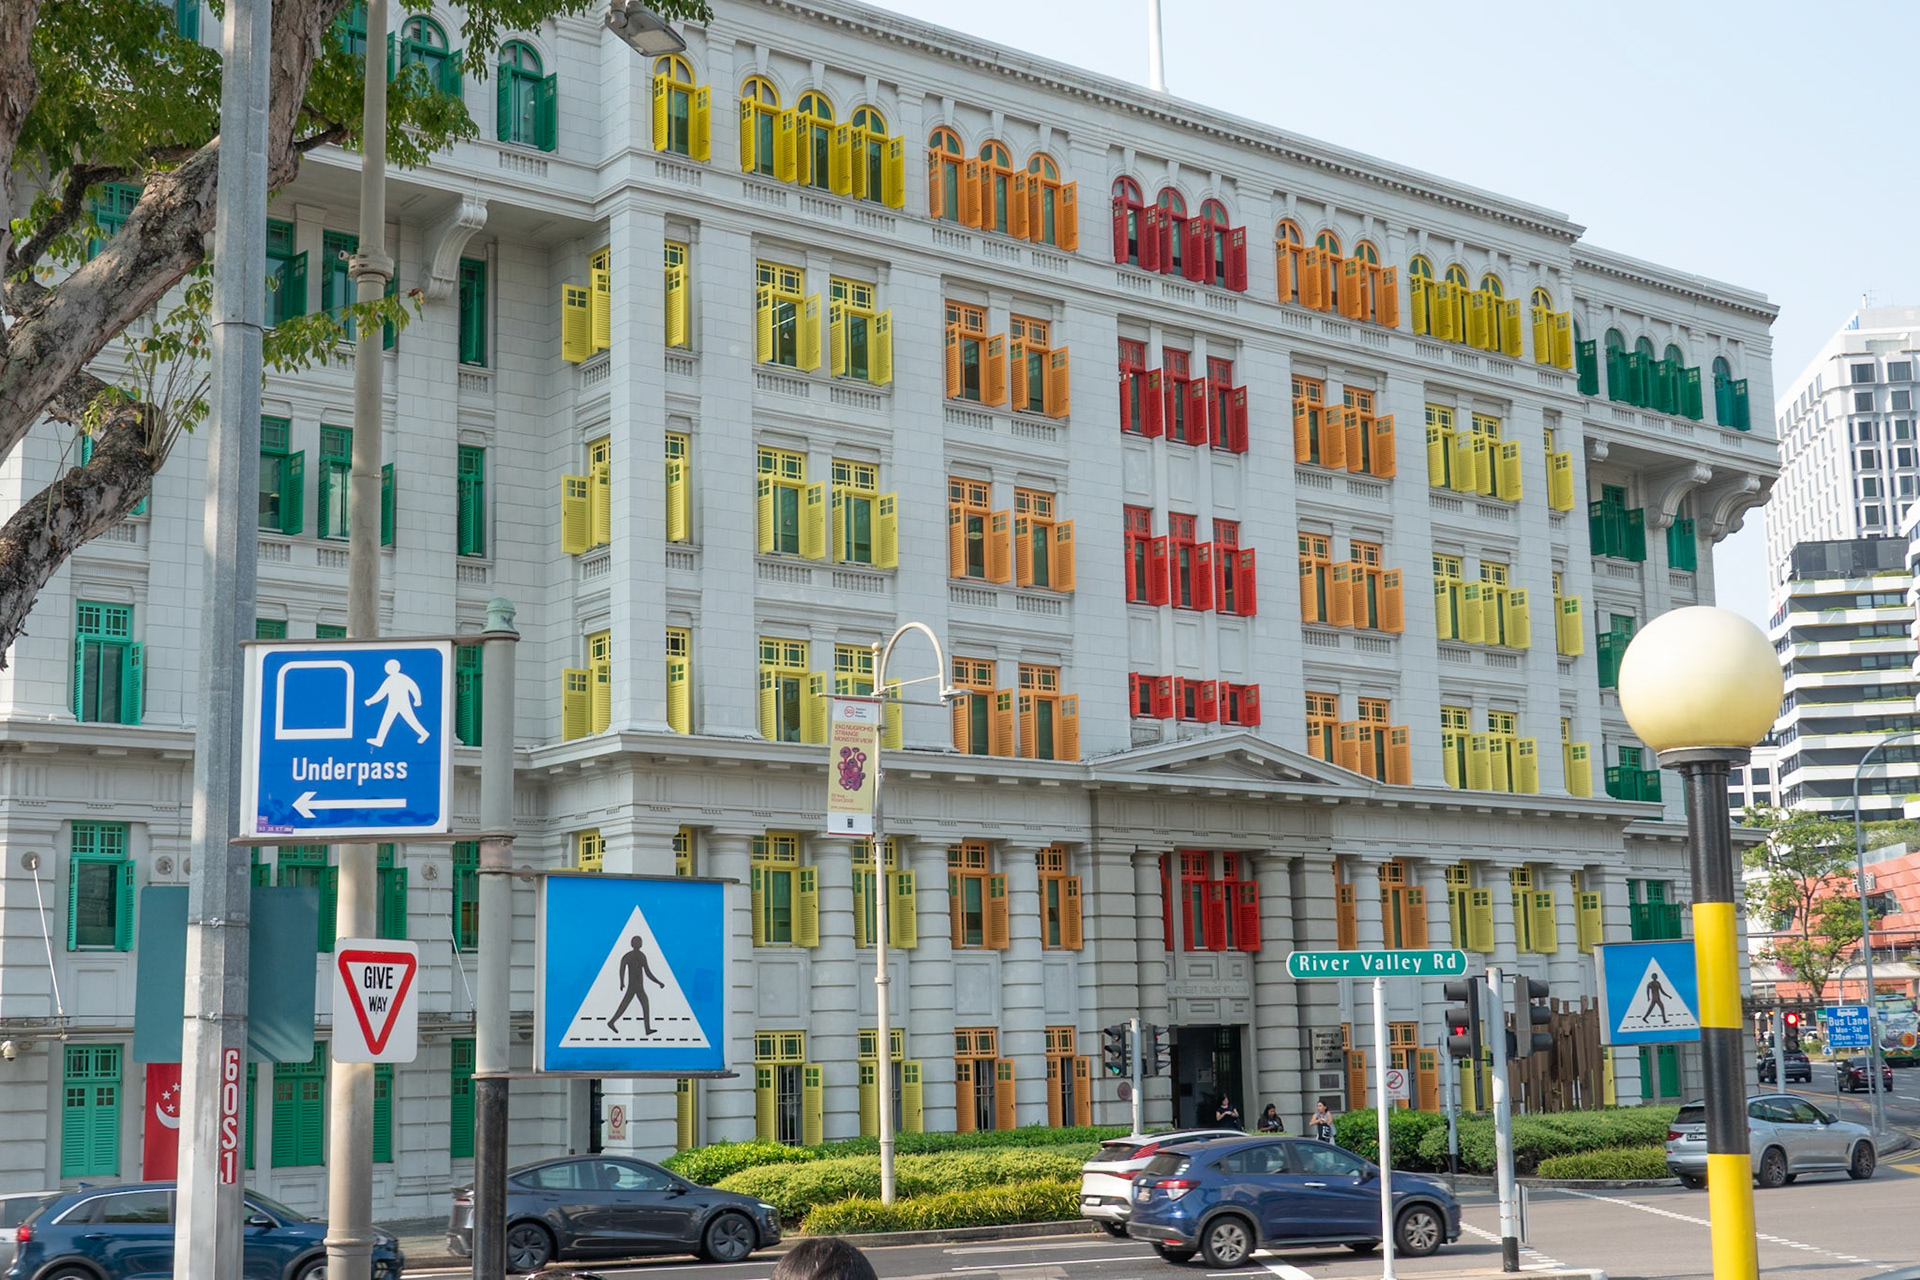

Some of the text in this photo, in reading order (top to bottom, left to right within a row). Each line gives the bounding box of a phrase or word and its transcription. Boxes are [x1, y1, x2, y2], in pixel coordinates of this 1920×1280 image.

[292, 757, 408, 786] Underpass
[1300, 953, 1456, 973] River Valley Rd
[364, 965, 393, 1012] GIVE WAY
[1829, 1016, 1868, 1026] Bus Lane
